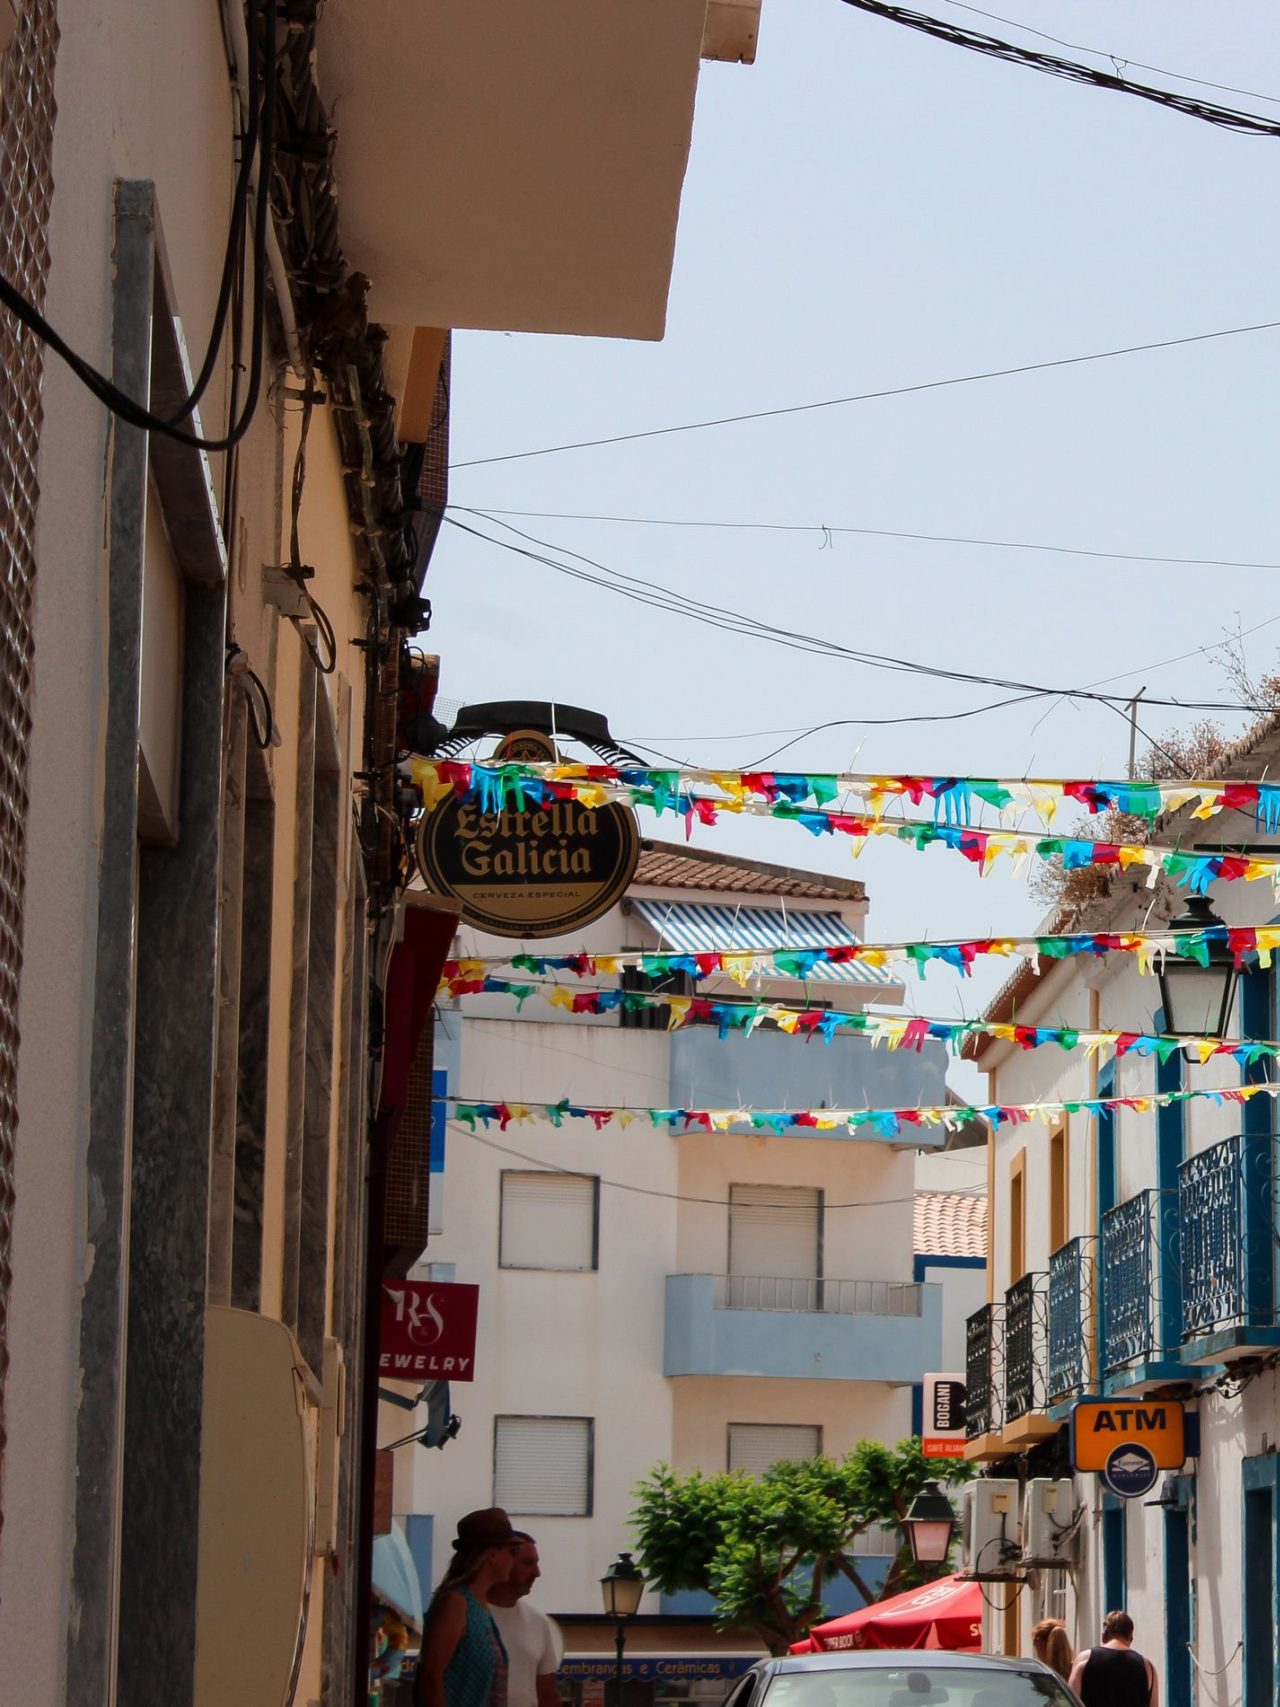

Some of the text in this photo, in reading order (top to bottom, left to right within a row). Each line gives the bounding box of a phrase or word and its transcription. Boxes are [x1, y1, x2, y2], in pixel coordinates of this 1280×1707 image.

[454, 803, 598, 838] Estrella
[462, 840, 592, 876] Galicia
[473, 891, 524, 899] CERVEZA
[380, 1353, 470, 1371] EWELRY
[936, 1384, 951, 1427] BOGANI
[1093, 1408, 1166, 1432] ATM
[640, 1663, 649, 1674] e
[655, 1660, 721, 1675] Cerâmicas
